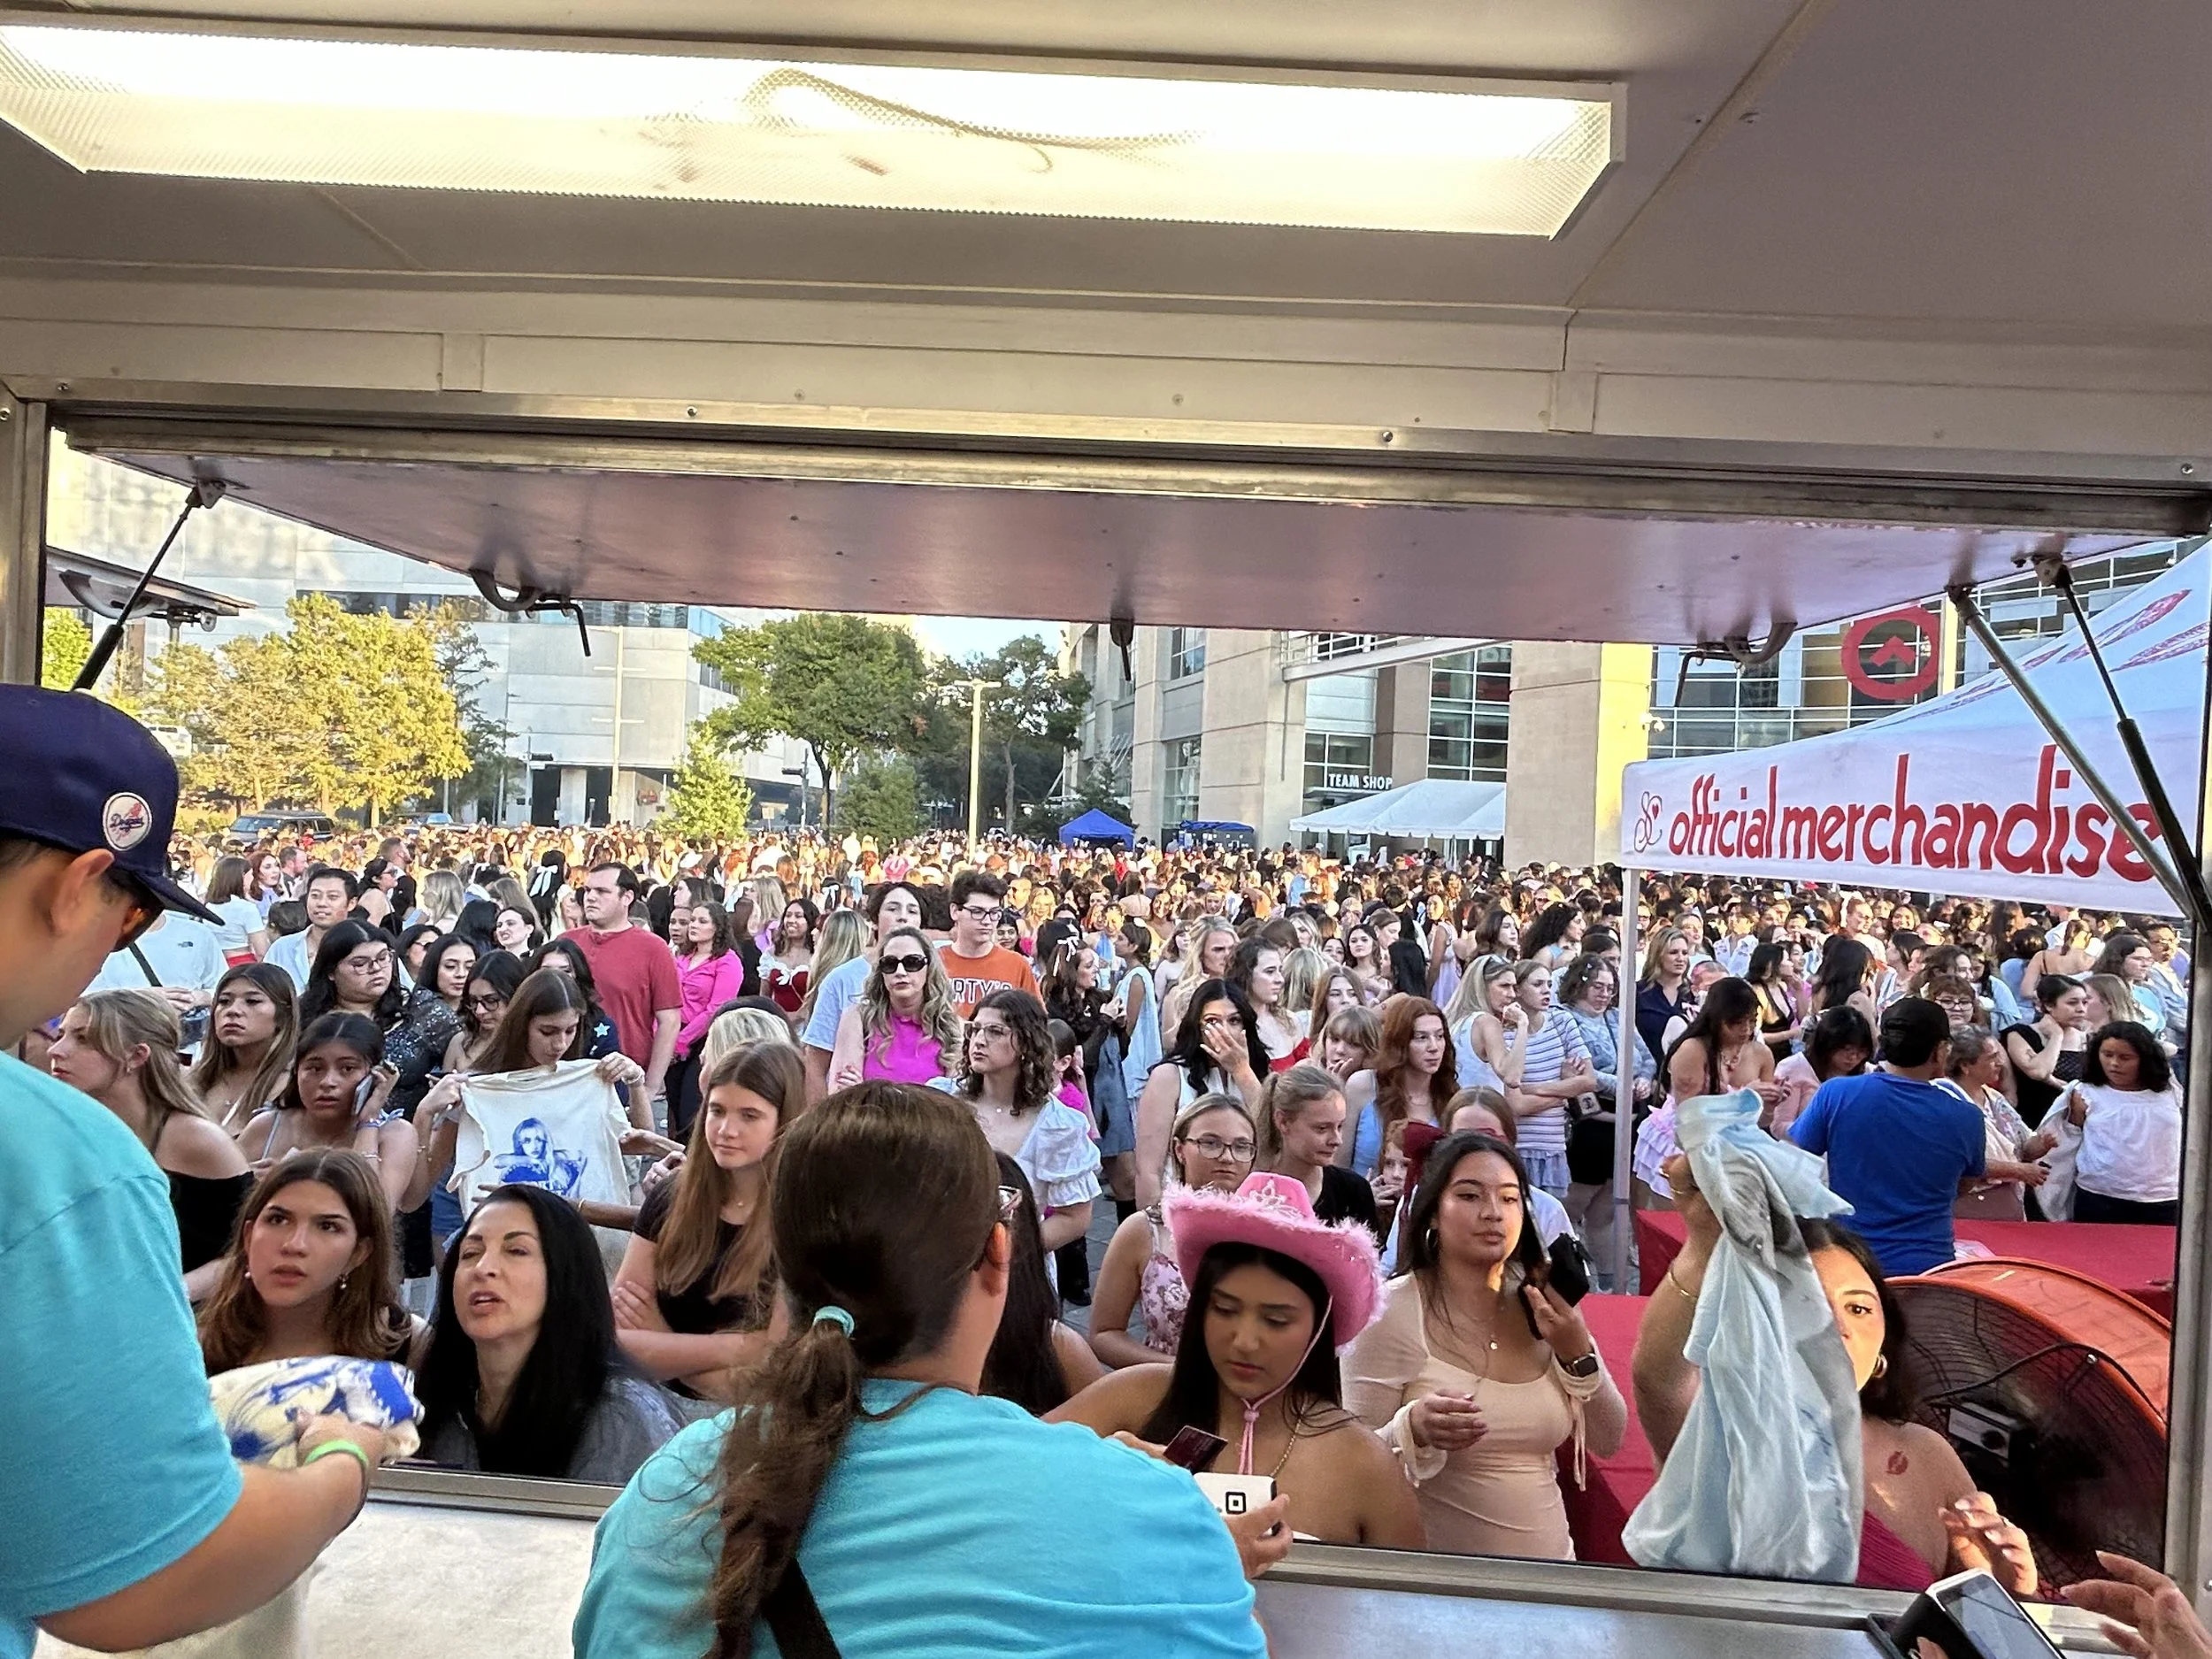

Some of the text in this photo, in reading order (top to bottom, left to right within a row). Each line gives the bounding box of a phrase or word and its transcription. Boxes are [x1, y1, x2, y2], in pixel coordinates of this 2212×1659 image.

[1329, 773, 1393, 790] TEAM SHOP
[1669, 765, 1778, 858] official
[1778, 745, 2162, 882] merchandise
